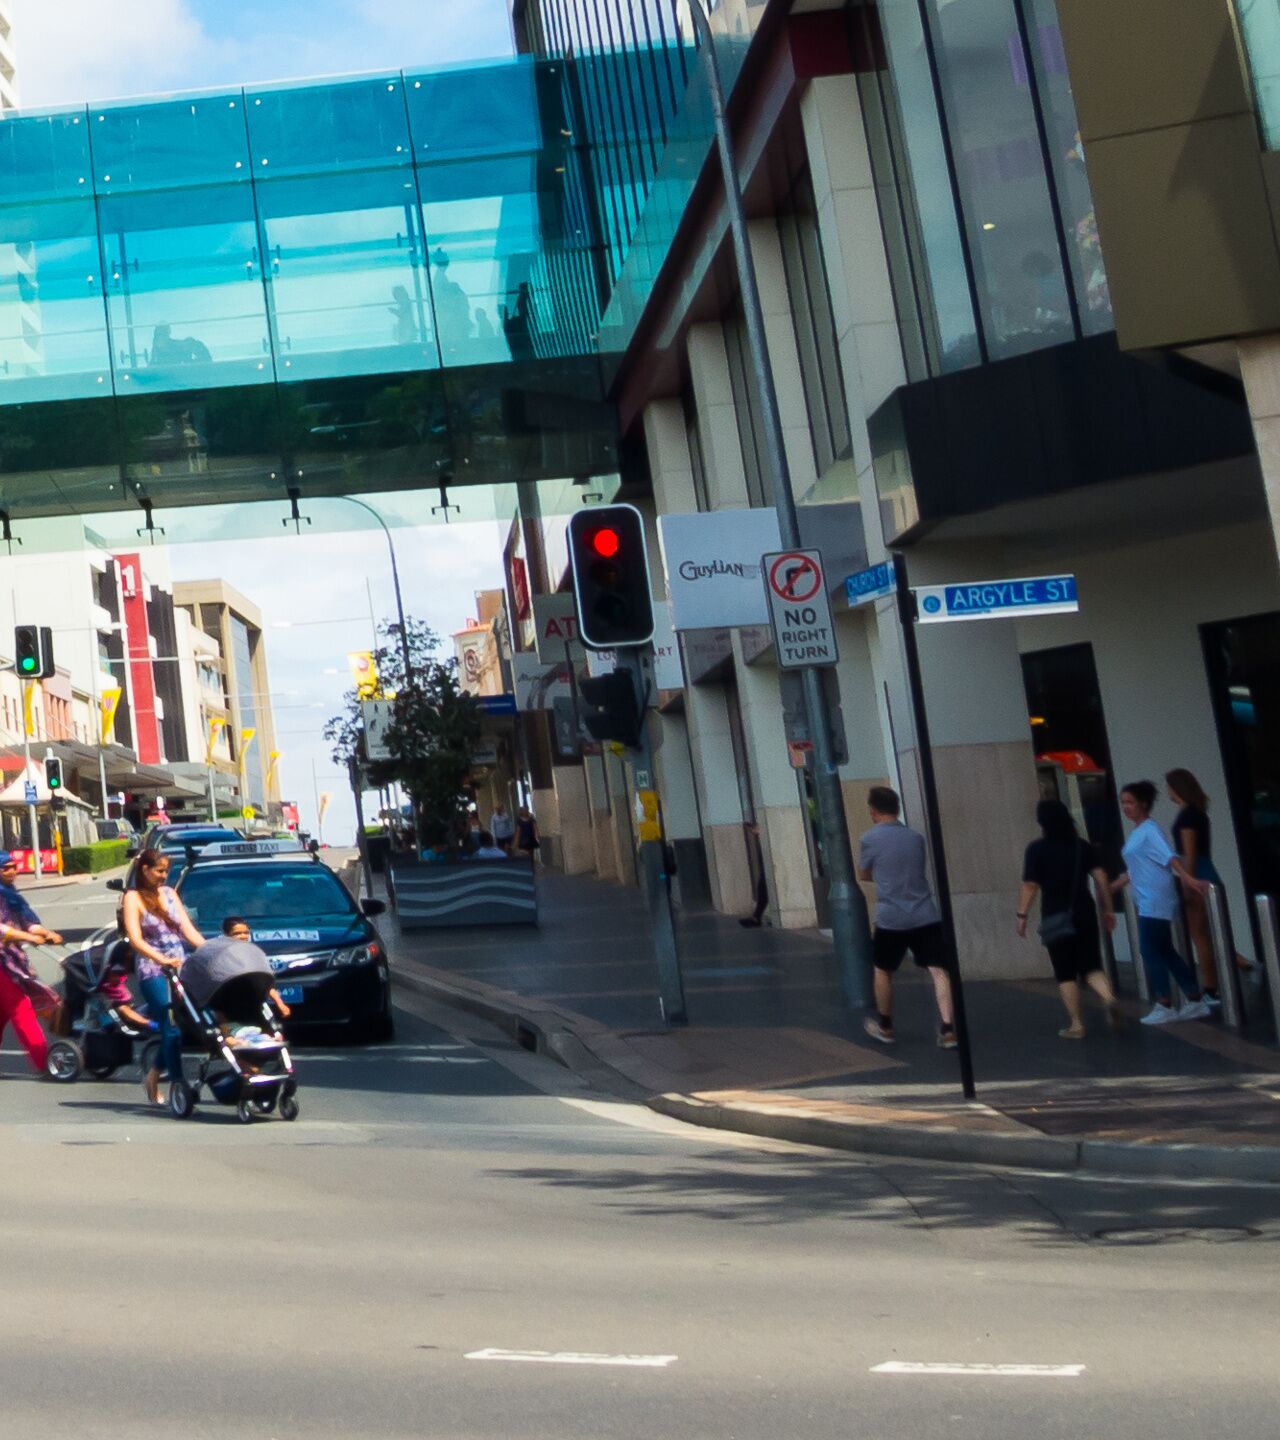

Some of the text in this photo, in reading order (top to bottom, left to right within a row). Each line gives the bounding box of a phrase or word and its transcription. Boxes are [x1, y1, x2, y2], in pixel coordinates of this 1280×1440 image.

[953, 579, 1071, 608] ARGYLE ST
[784, 607, 817, 626] NO
[782, 628, 828, 644] RIGHT
[785, 644, 829, 660] TURN
[258, 843, 279, 852] TAXI
[255, 930, 318, 940] CABS
